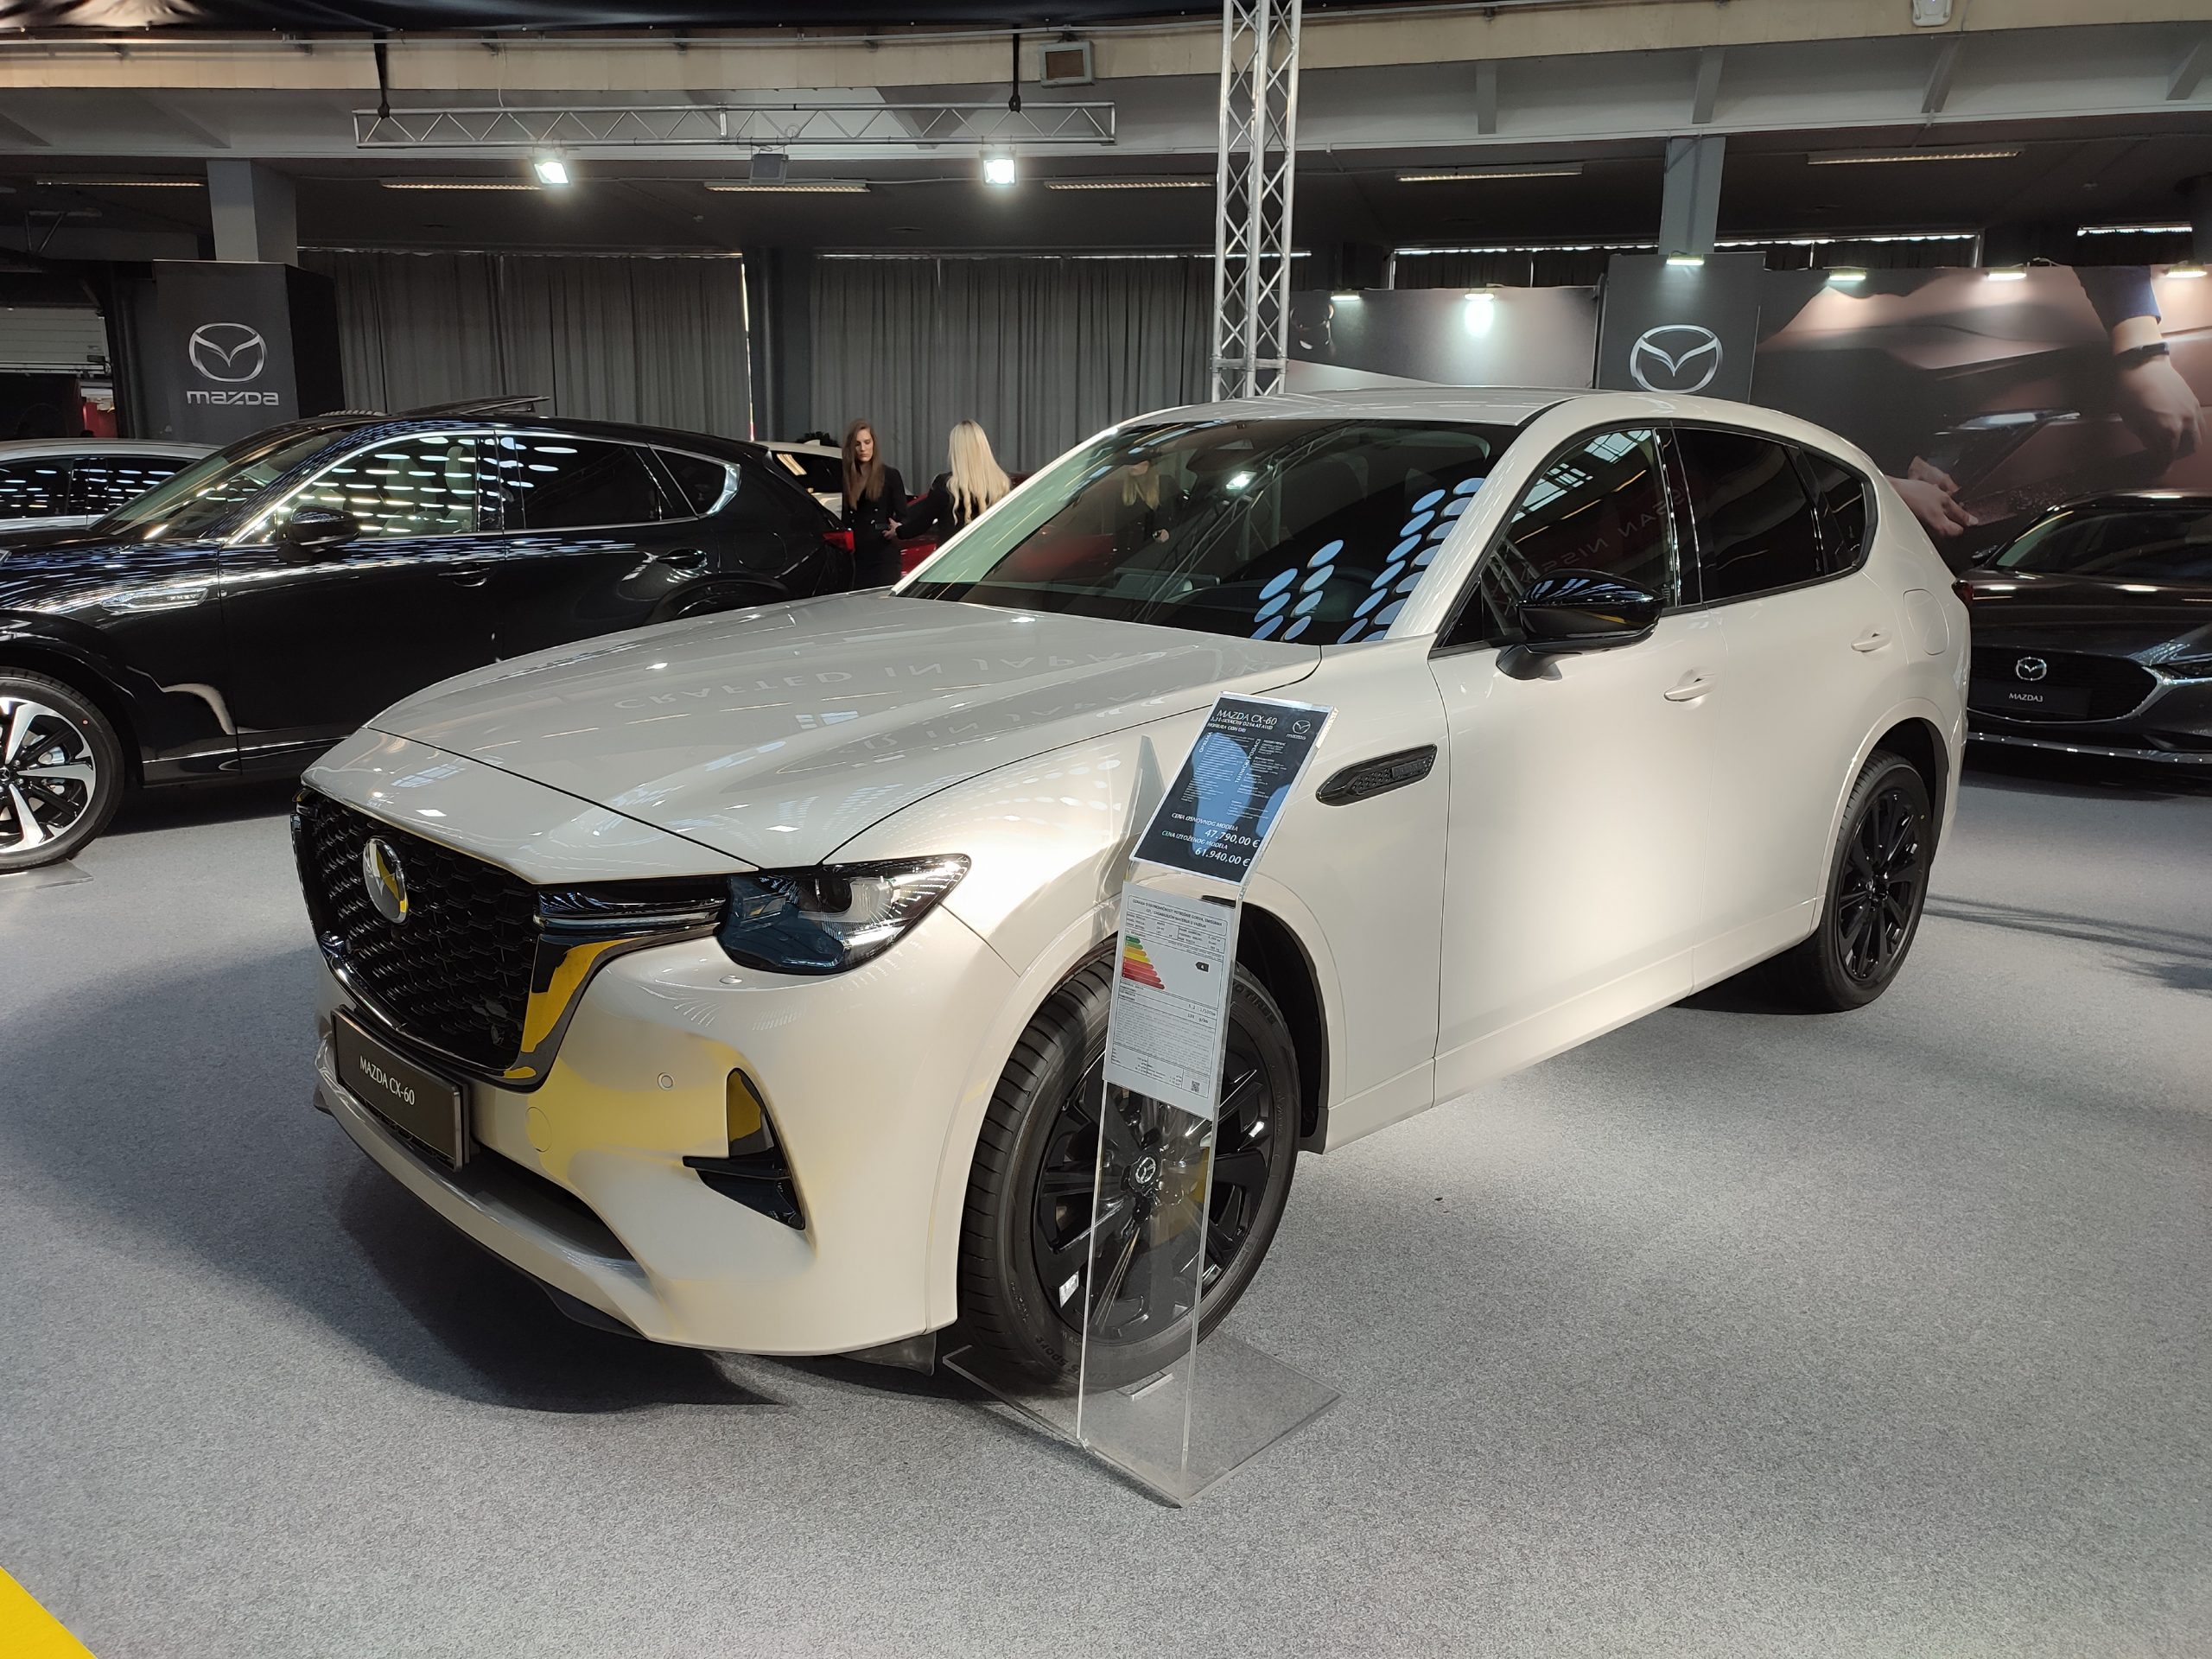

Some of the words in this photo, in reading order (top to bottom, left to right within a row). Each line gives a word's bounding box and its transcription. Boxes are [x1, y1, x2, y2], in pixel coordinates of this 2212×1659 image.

[2008, 692, 2044, 702] MAZDA3
[1216, 709, 1251, 721] MAZDA
[1249, 714, 1278, 725] CX-60
[1215, 822, 1239, 831] MODELA
[1203, 828, 1252, 846] 47.790,00
[1253, 839, 1261, 849] €
[1193, 847, 1243, 865] 61.940,00
[1243, 858, 1251, 867] €
[359, 1055, 389, 1090] MAZDA
[389, 1077, 416, 1106] CX-60
